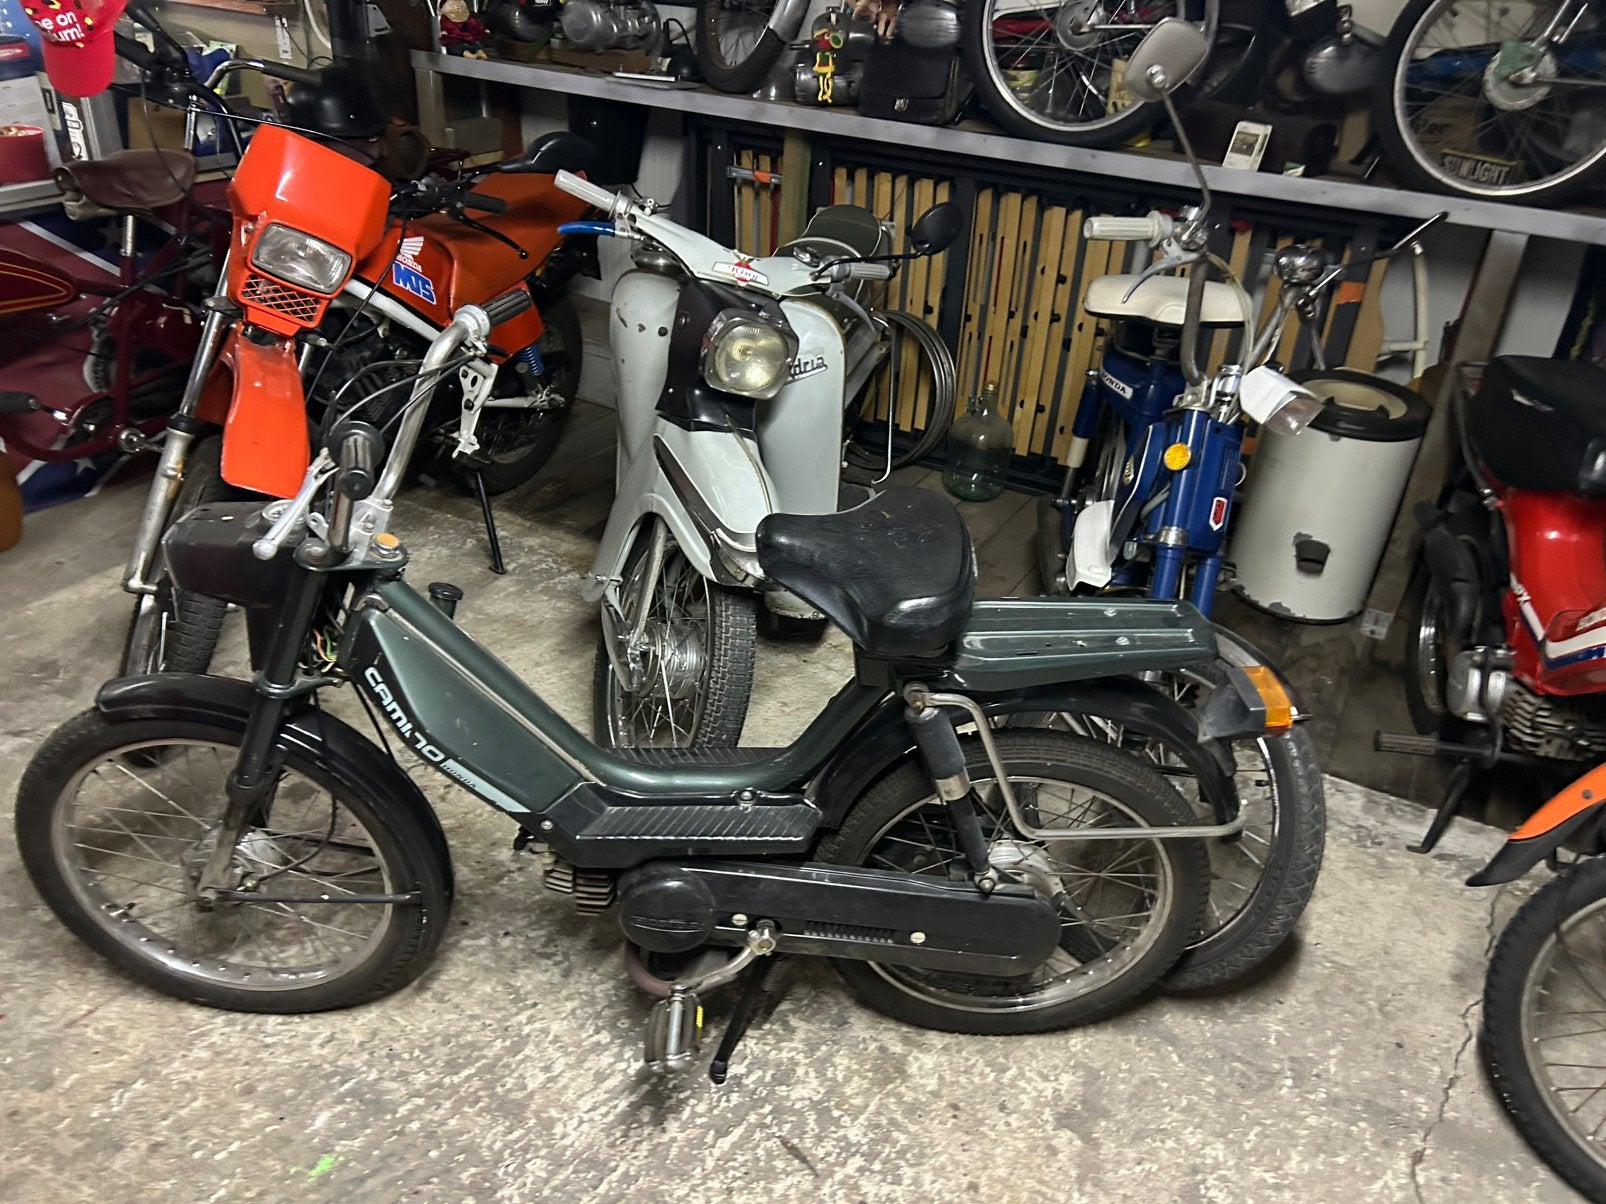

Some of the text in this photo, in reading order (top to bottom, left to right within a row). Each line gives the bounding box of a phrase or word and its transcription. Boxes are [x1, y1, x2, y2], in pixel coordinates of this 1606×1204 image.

[56, 11, 77, 26] on
[1442, 155, 1512, 185] SUNLIGHT
[789, 356, 826, 377] dria
